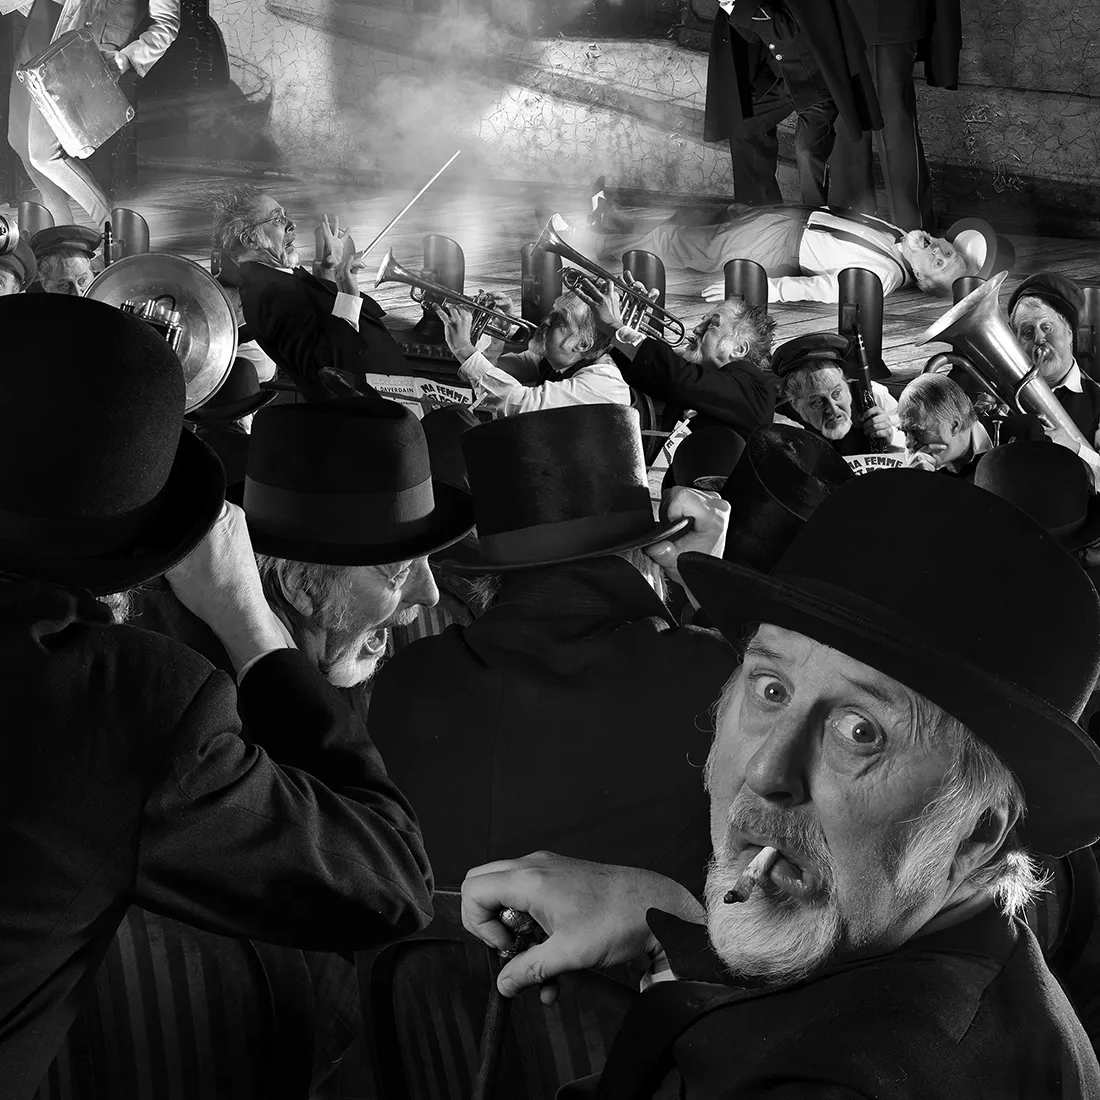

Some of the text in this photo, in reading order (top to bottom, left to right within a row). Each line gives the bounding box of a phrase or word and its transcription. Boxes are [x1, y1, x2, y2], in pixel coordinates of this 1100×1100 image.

[420, 383, 436, 394] MA
[435, 384, 470, 404] FEMME
[864, 456, 904, 469] FEMME
